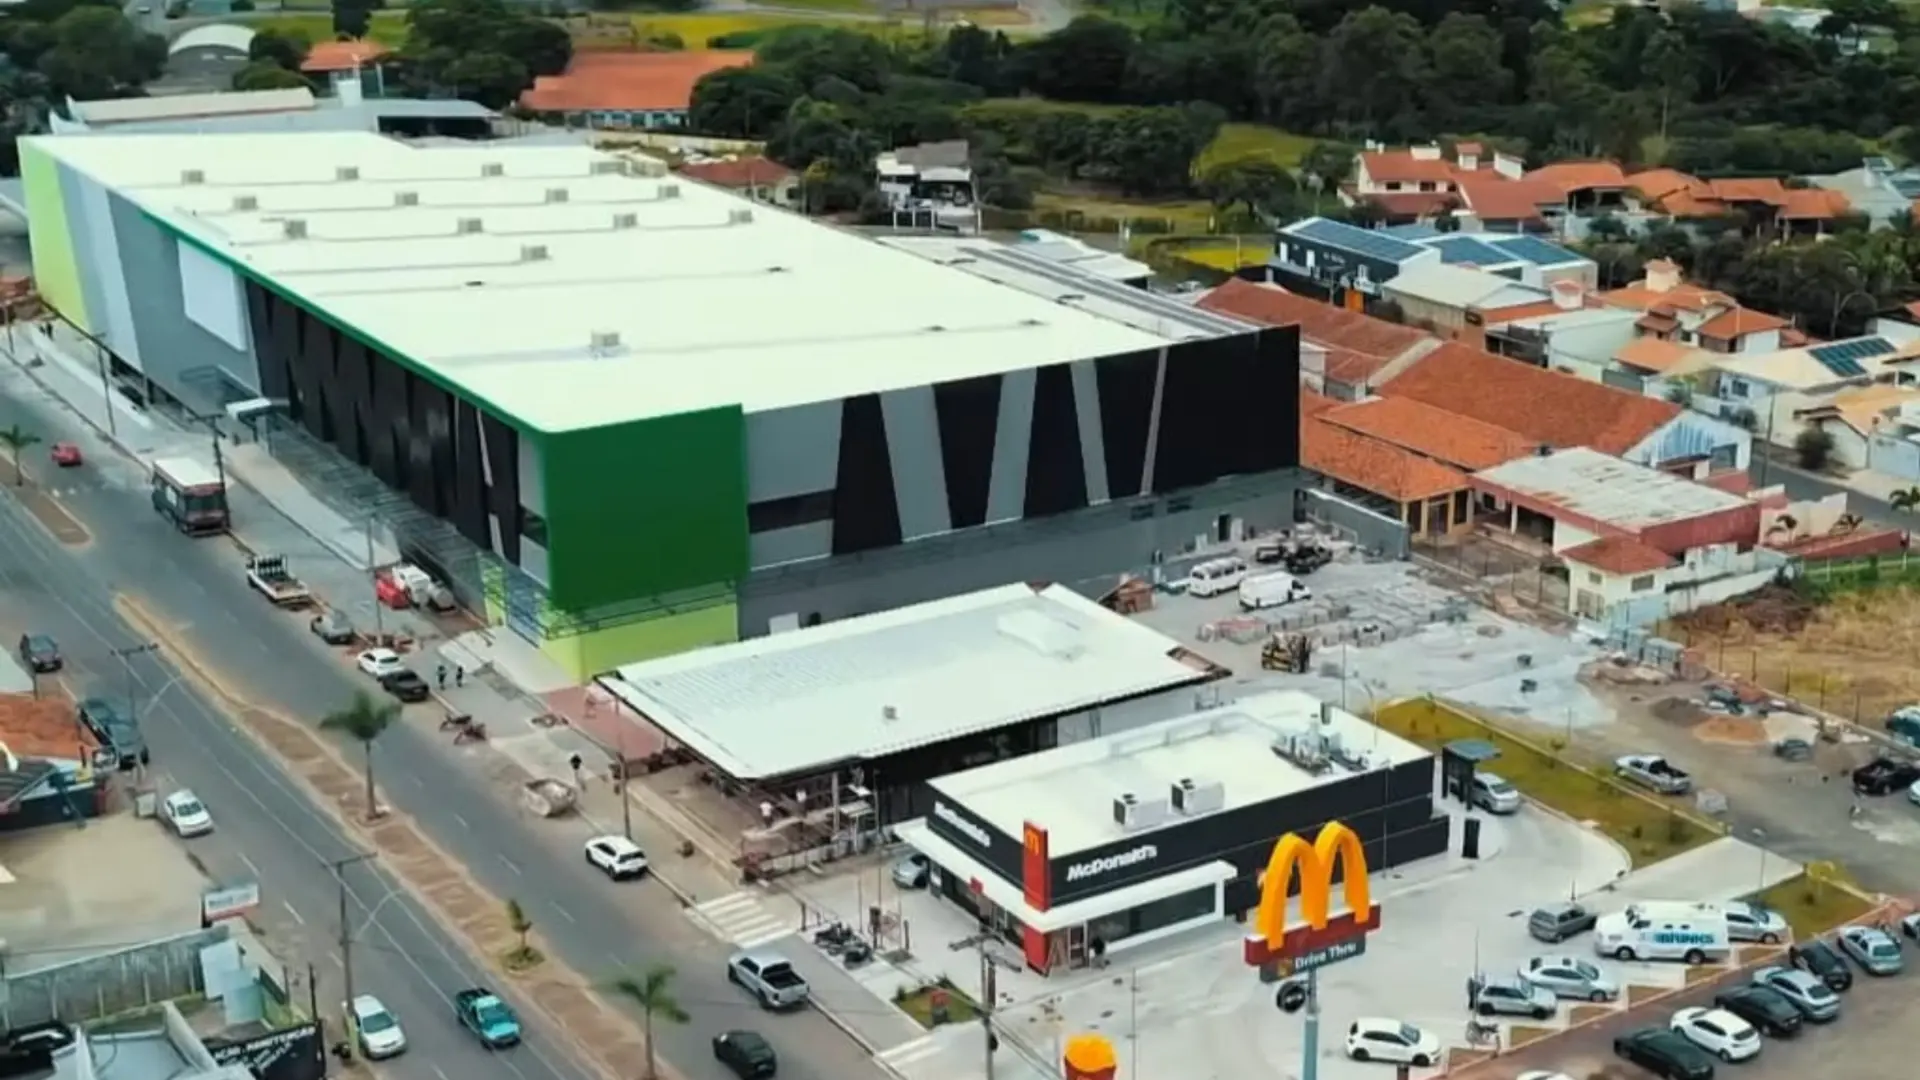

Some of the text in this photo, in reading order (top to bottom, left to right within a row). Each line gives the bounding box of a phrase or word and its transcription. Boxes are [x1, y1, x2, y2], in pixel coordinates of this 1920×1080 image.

[1066, 844, 1158, 881] McDonald's
[1294, 942, 1357, 969] Drive Thru
